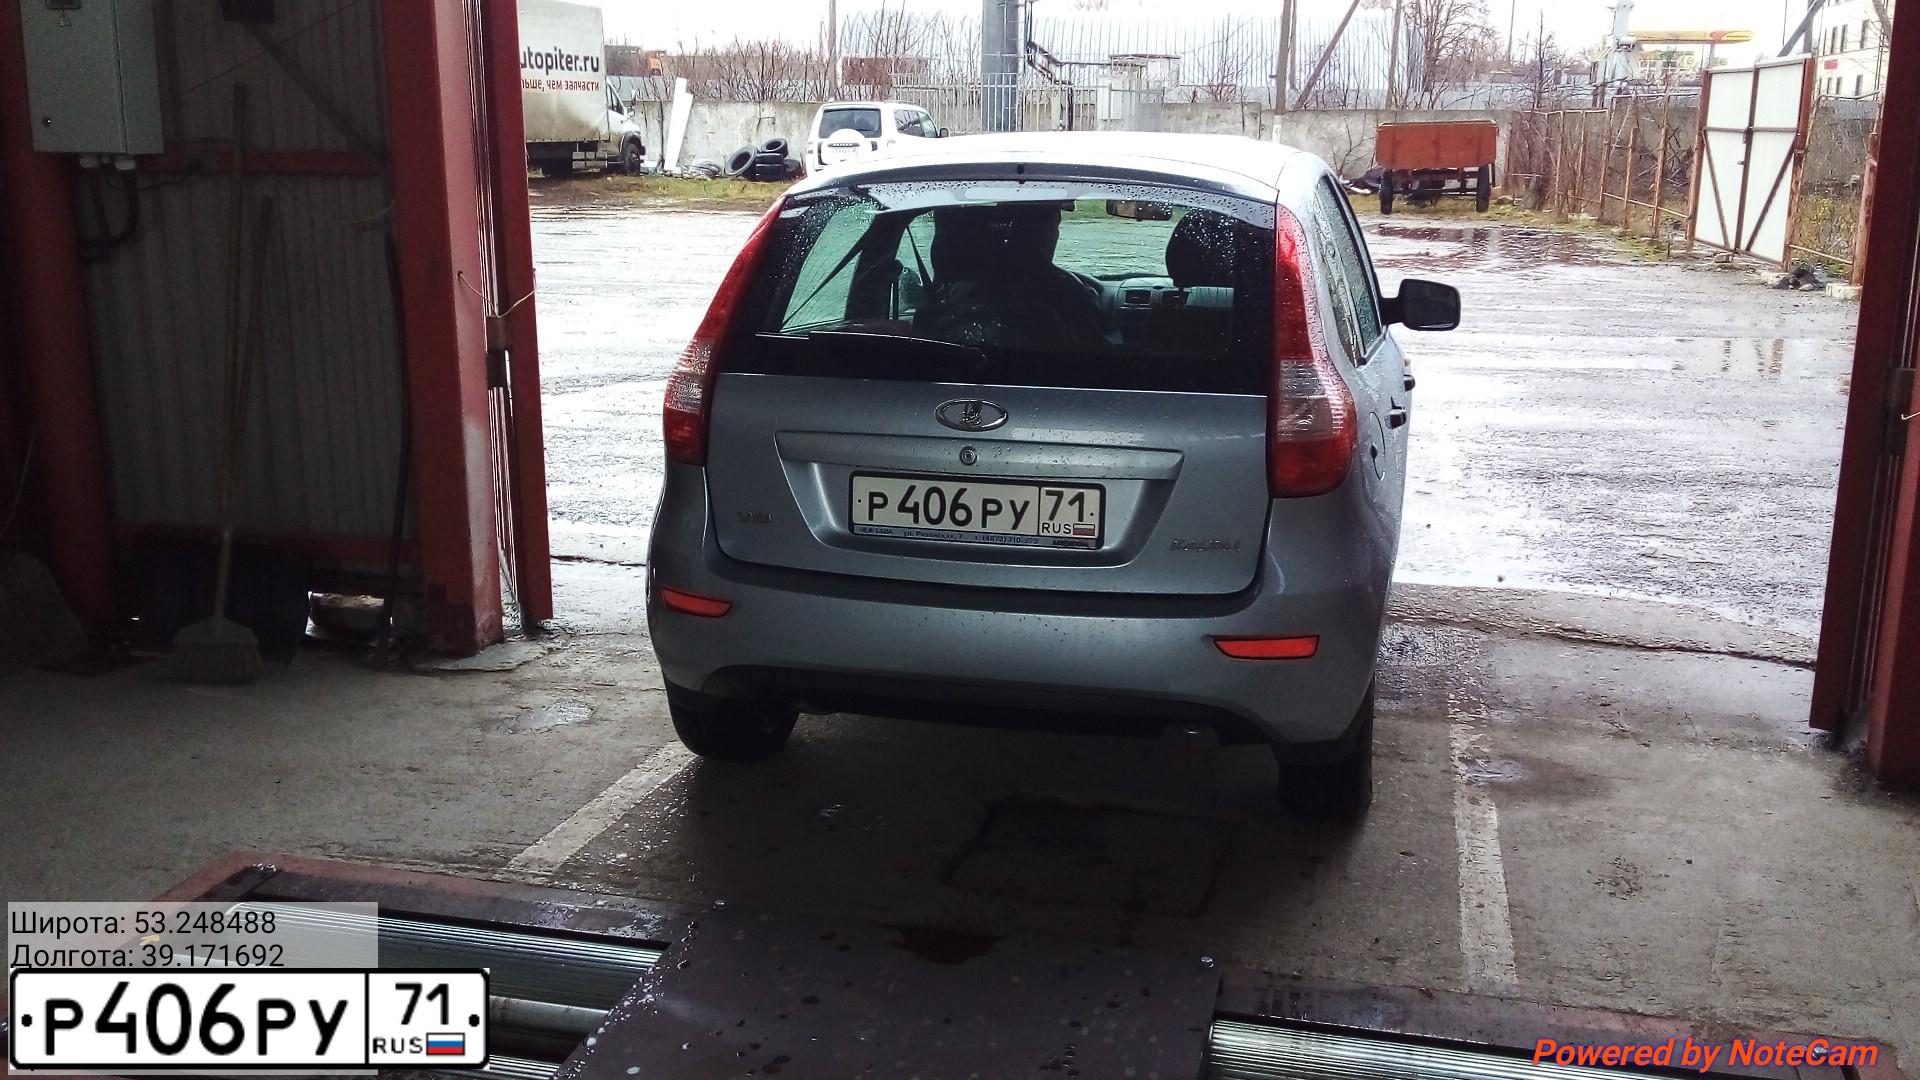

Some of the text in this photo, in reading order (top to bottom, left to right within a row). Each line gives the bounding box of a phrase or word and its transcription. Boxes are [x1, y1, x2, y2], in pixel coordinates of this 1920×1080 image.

[546, 79, 563, 90] чем
[565, 79, 599, 91] запчасти
[1045, 490, 1085, 522] 71
[1041, 522, 1071, 534] RUS
